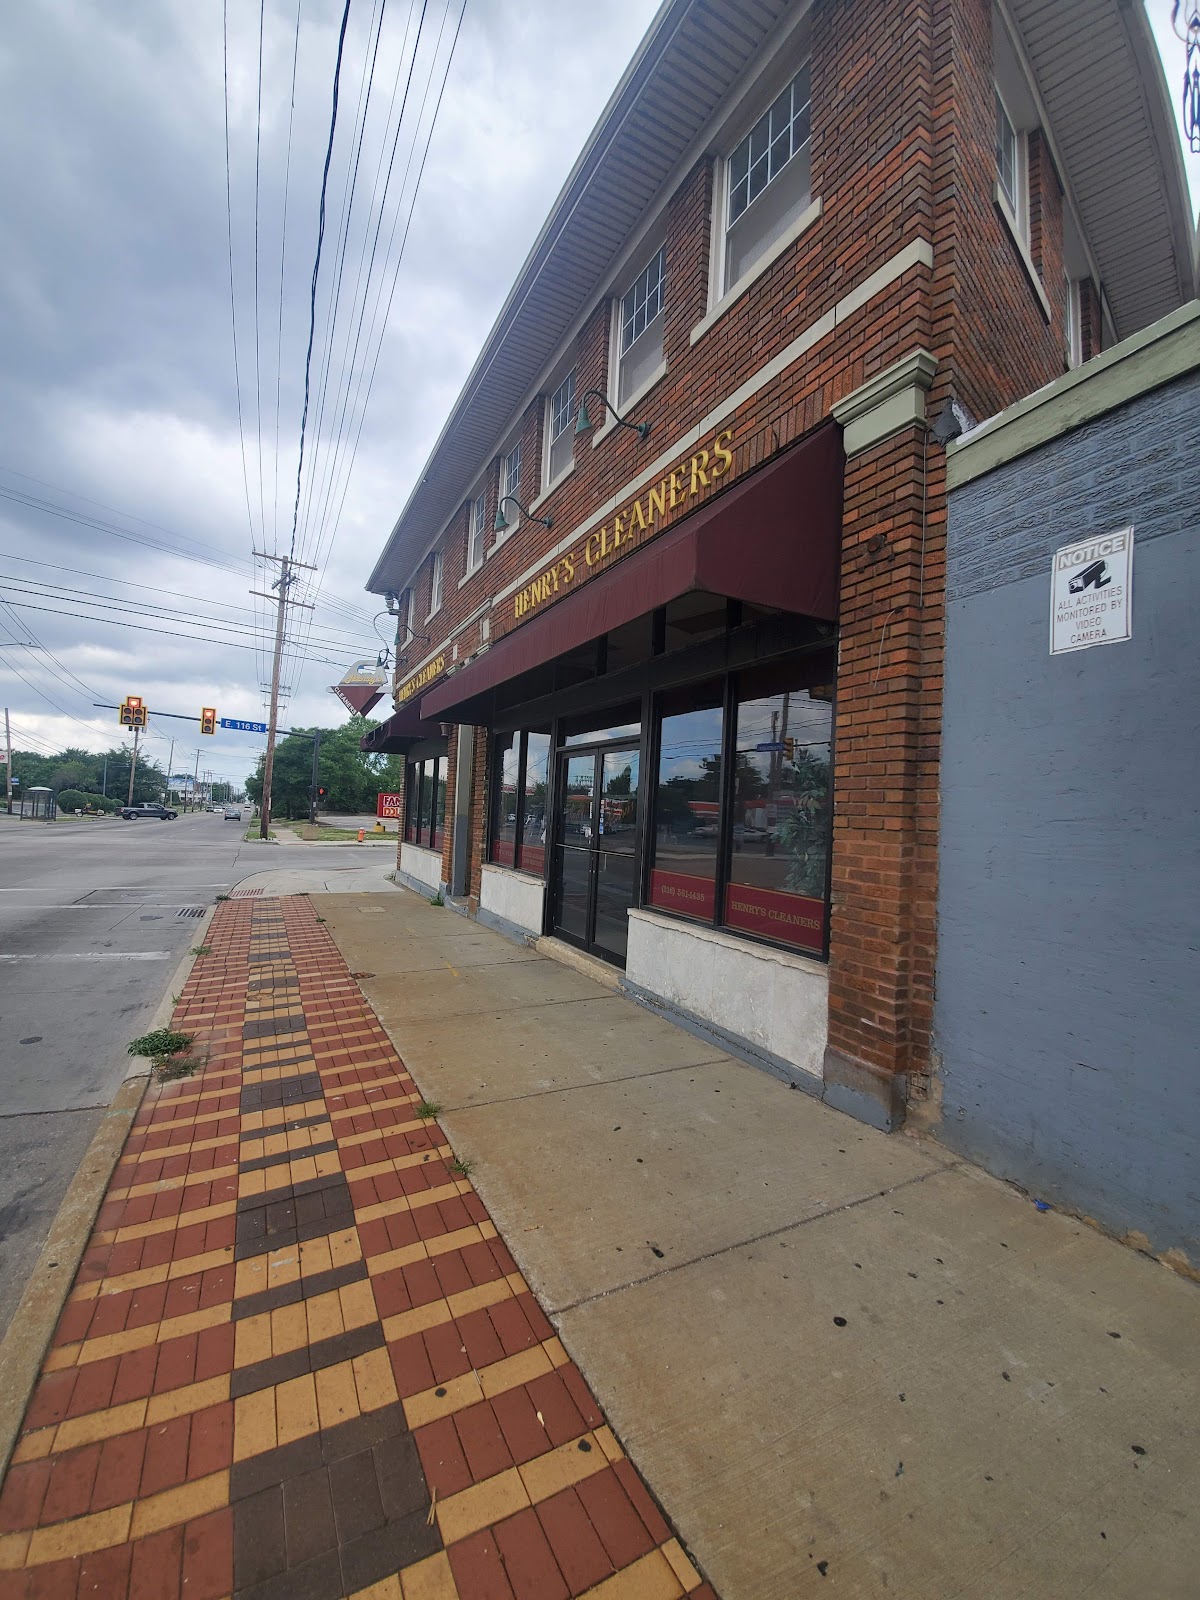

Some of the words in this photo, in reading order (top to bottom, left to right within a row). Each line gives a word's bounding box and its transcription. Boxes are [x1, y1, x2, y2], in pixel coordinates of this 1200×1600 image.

[514, 552, 575, 619] HENRY'S
[585, 430, 734, 567] CLEANERS
[1060, 535, 1124, 569] NOTICE
[1057, 602, 1107, 623] MONITORED
[1111, 599, 1123, 610] BY
[1058, 601, 1073, 611] ALL
[1076, 586, 1123, 607] ACTIVITIES
[1076, 617, 1102, 630] VIDEO
[1071, 629, 1107, 644] CAMERA
[335, 687, 358, 715] CLEANERS
[236, 722, 250, 730] 116
[731, 900, 767, 917] HENRY'S
[768, 909, 821, 931] CLEANERS
